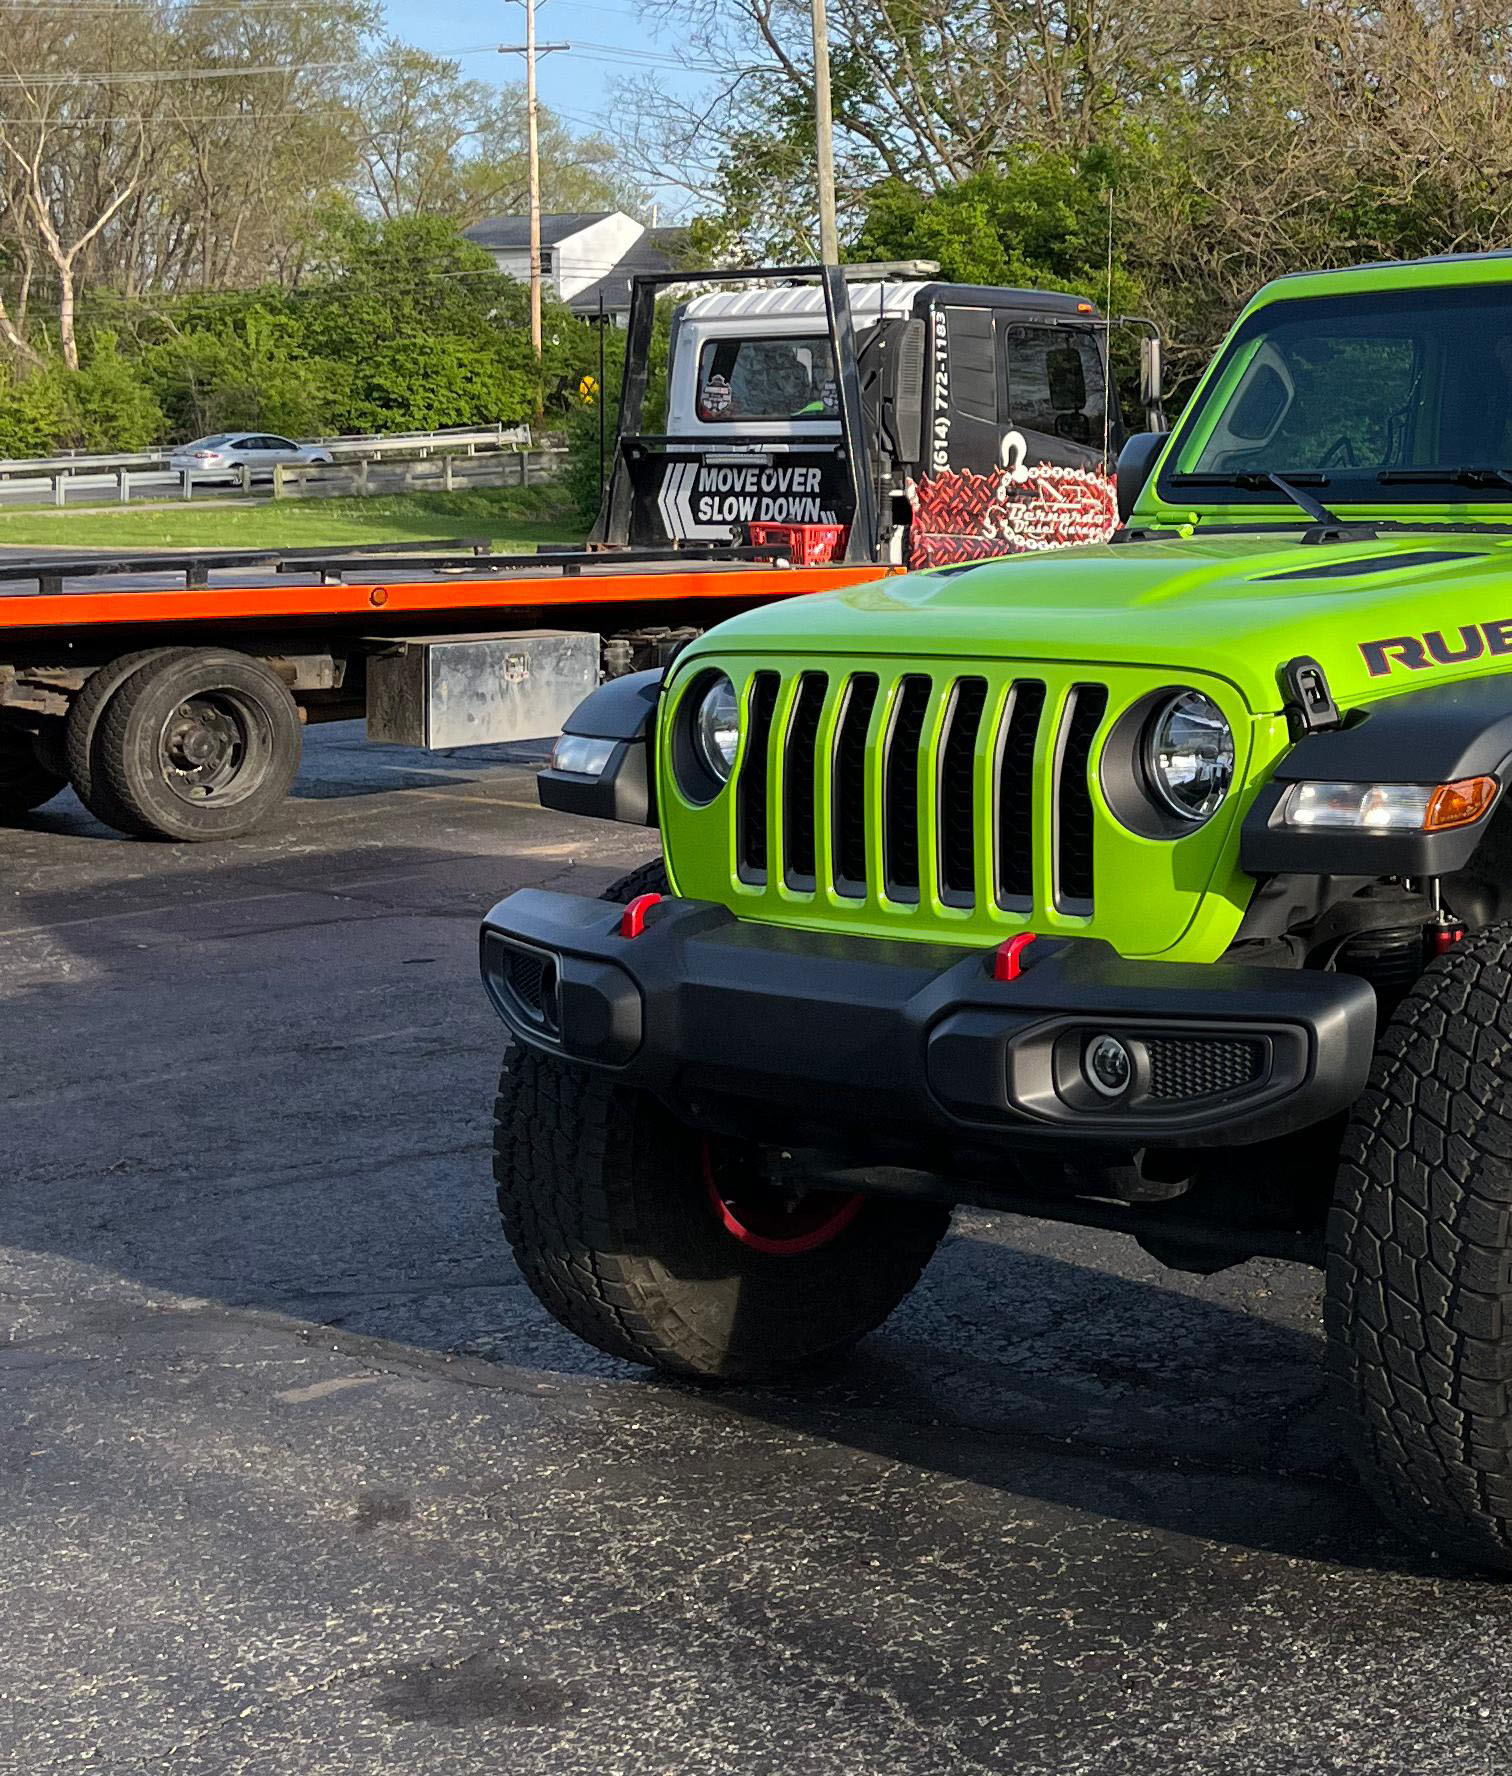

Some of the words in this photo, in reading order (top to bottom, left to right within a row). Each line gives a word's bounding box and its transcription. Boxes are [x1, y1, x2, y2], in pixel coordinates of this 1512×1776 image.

[935, 311, 949, 411] 772-1183
[933, 416, 951, 472] (614)
[699, 467, 761, 492] MOVE
[761, 467, 822, 493] OVER
[698, 496, 758, 521] SLOW
[760, 497, 821, 523] DOWN
[1014, 520, 1054, 535] Diesel
